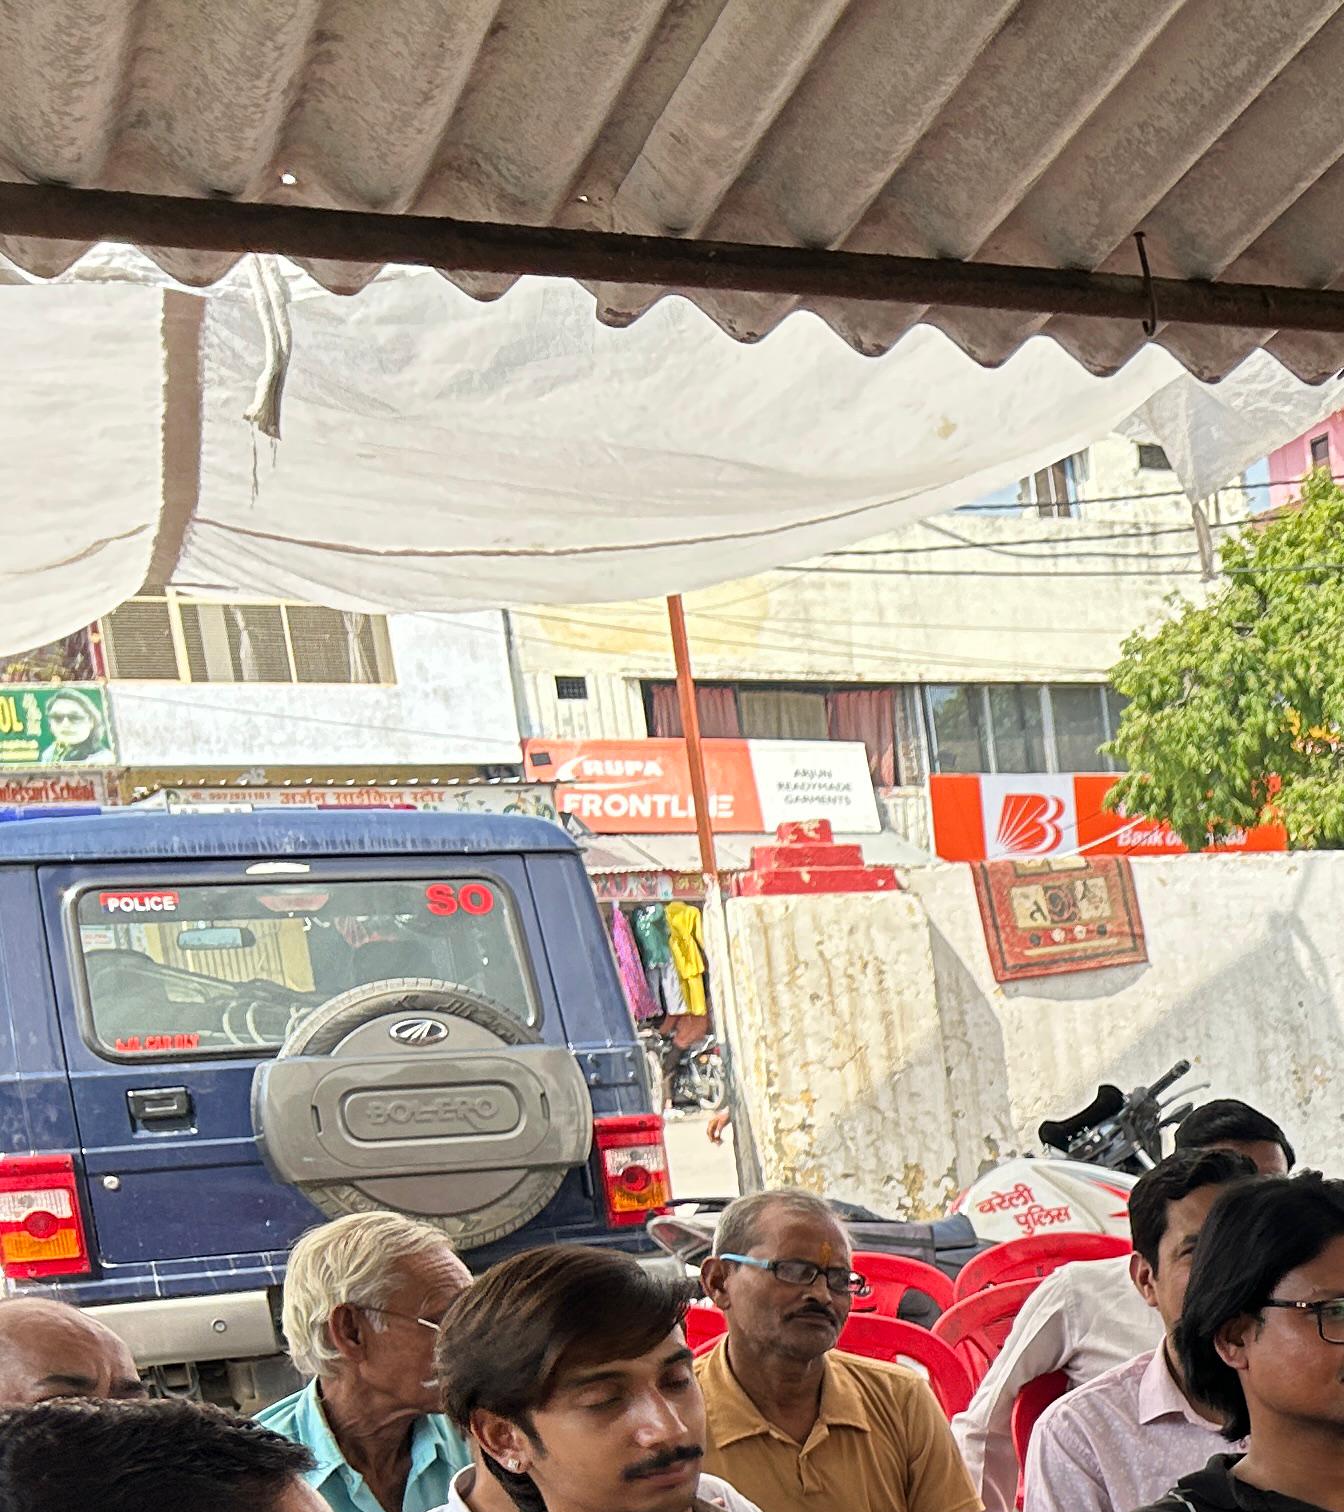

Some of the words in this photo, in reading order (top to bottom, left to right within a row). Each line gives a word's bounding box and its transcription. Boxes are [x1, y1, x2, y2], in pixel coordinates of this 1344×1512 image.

[583, 759, 664, 777] RUPA
[1117, 828, 1165, 847] Bank
[107, 896, 176, 913] POLICE
[425, 883, 494, 916] SO
[368, 1096, 498, 1131] BOLERO
[976, 1183, 1036, 1214] बरेली
[1014, 1204, 1072, 1236] पुलिस
